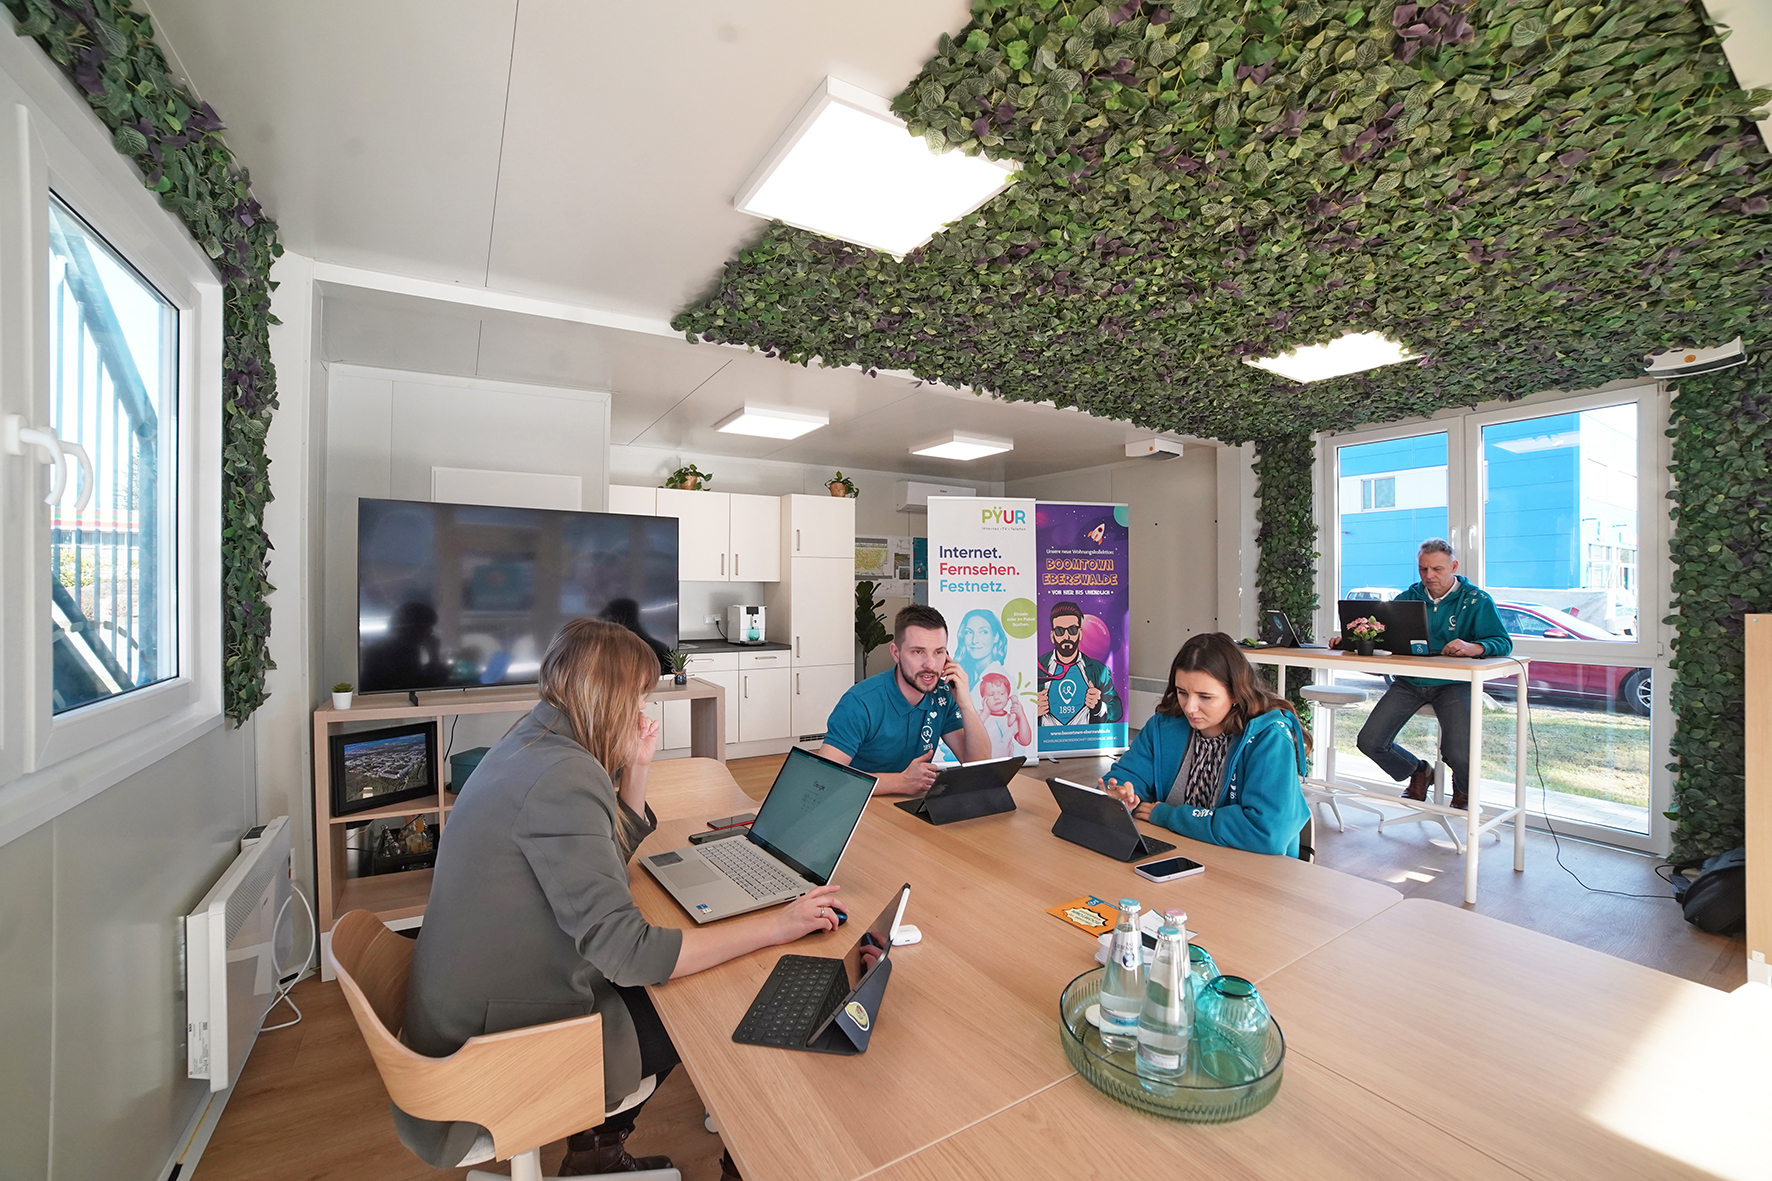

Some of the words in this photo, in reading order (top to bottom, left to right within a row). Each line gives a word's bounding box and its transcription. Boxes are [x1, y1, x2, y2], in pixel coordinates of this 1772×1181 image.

[982, 506, 1026, 524] PŸUR
[939, 545, 1002, 559] Internet.
[939, 562, 1020, 576] Fernsehen.
[1045, 558, 1114, 571] BOOMTOWN
[940, 579, 1007, 593] Festnetz.
[1042, 572, 1119, 586] EBERSWALDE
[1059, 706, 1075, 714] 1893
[1050, 728, 1111, 736] www.boomtown-eberswalde.de
